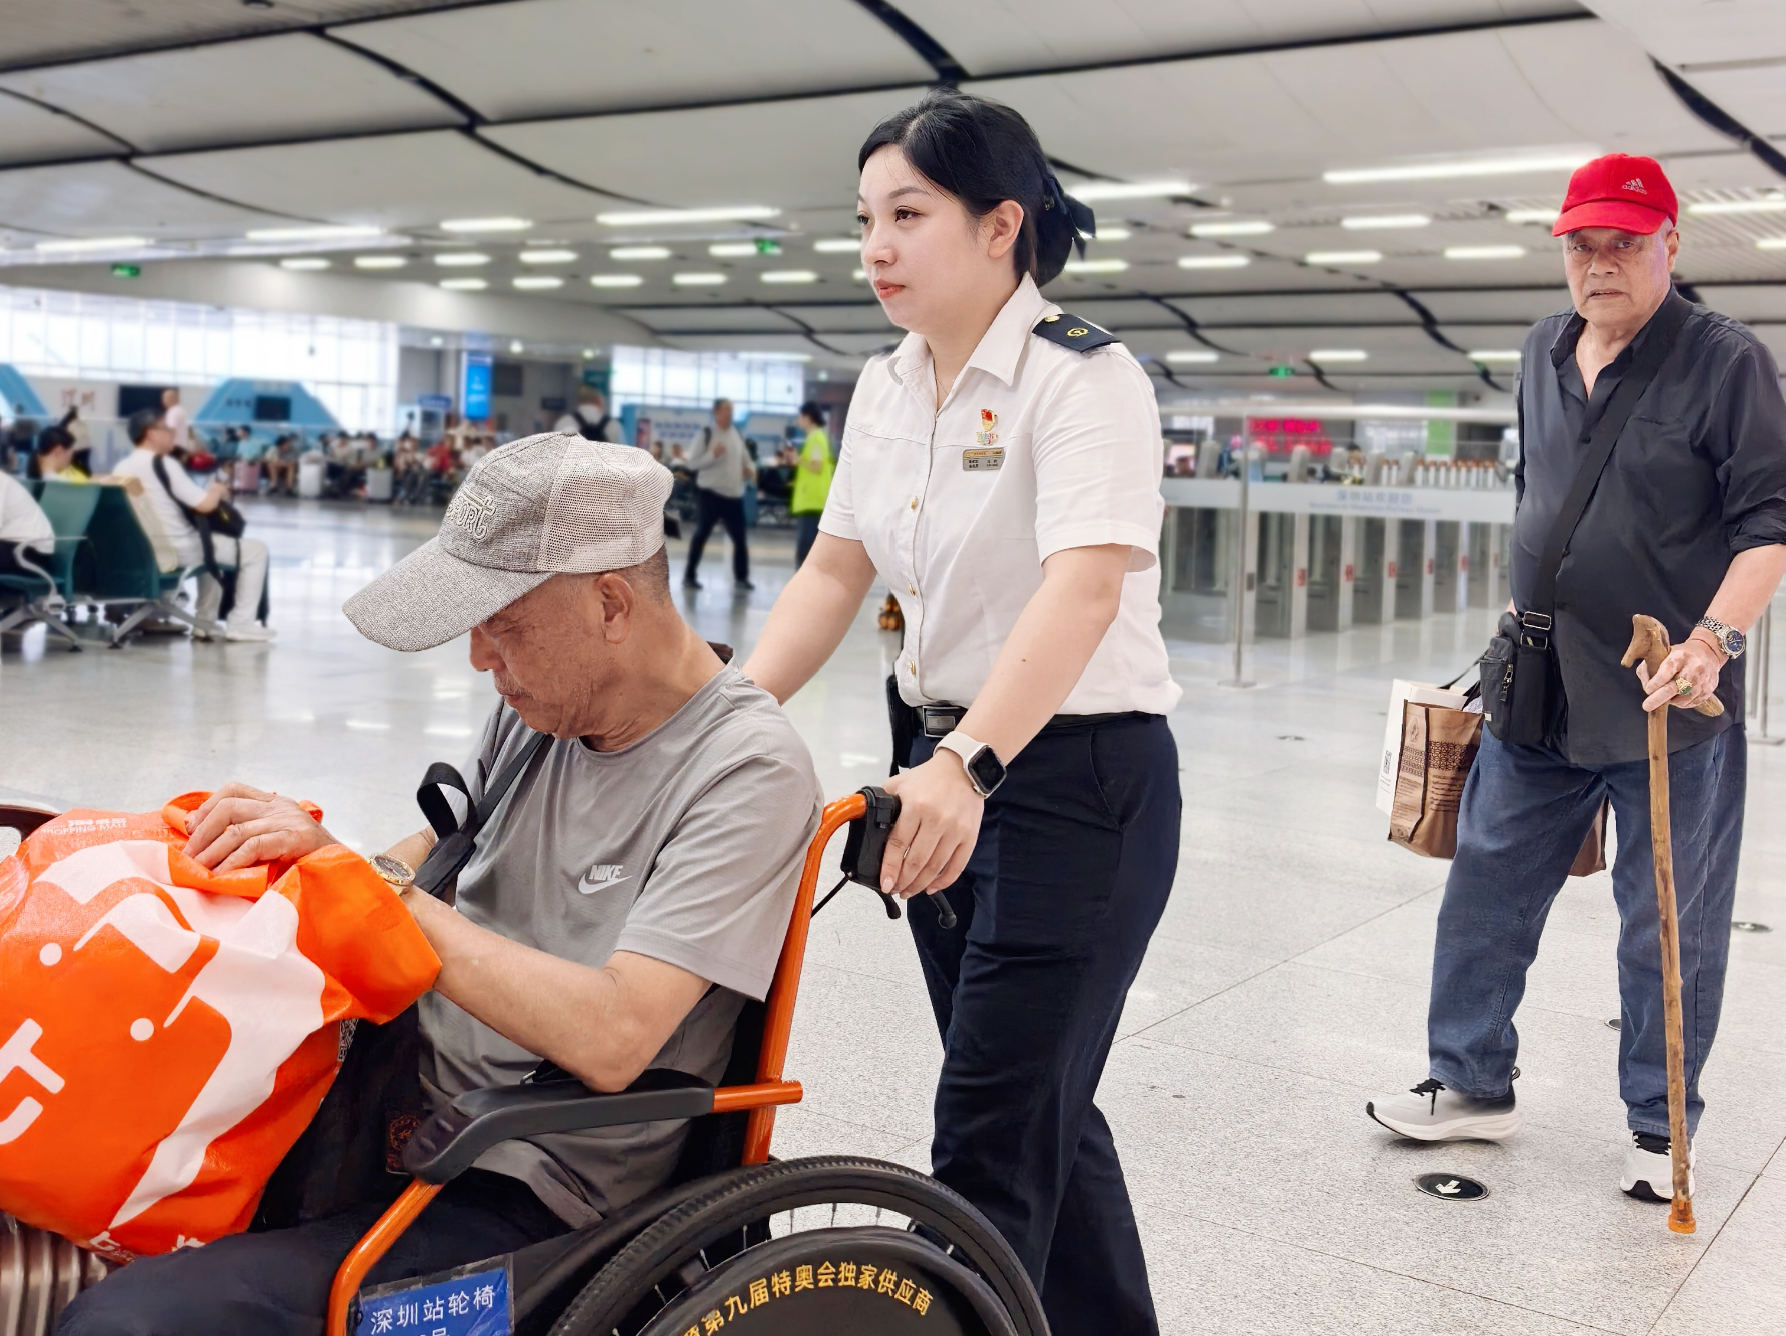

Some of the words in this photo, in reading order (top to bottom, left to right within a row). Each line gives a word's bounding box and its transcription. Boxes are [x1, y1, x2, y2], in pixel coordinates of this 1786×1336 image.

[589, 864, 624, 880] NIKE
[370, 1284, 496, 1335] 深圳站轮椅
